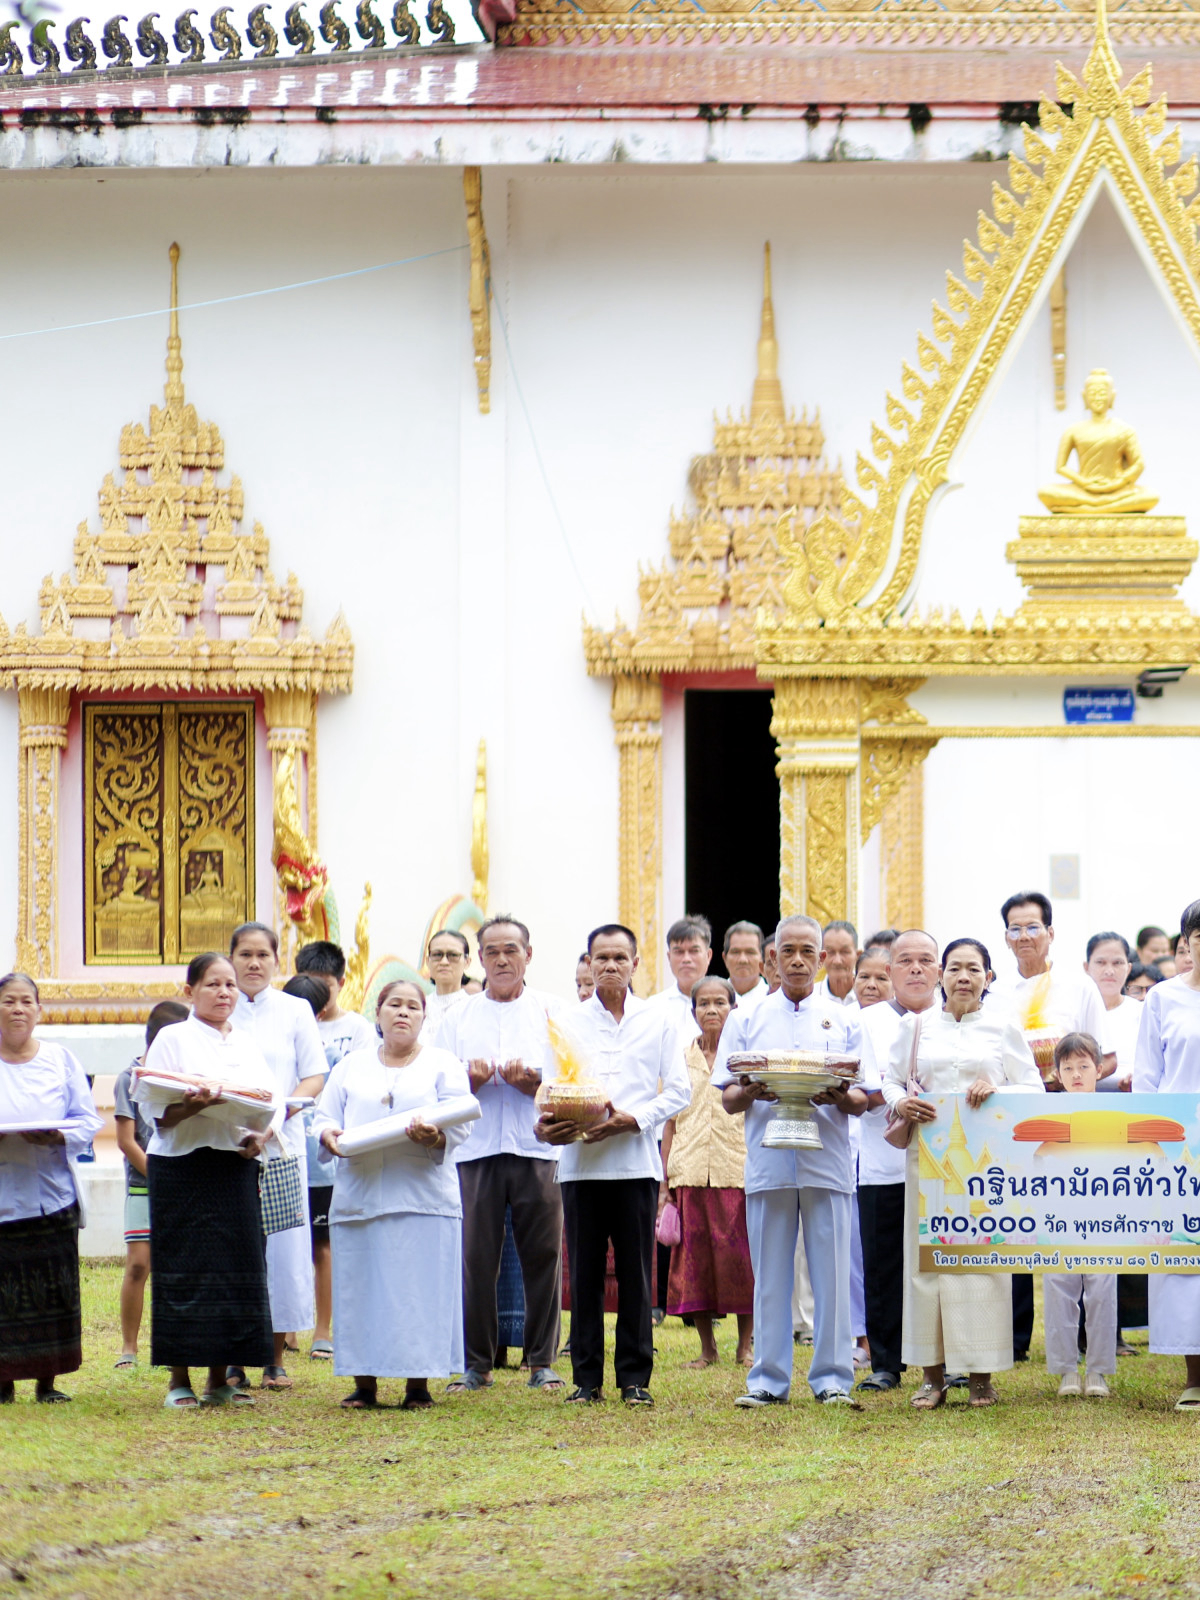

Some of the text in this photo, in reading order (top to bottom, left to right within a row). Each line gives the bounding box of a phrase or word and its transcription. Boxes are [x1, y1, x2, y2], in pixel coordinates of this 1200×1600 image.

[930, 1215, 1036, 1236] ๓๐,๐๐๐
[1044, 1213, 1067, 1233] วัด
[1073, 1213, 1174, 1240] พุทธศักราช
[933, 1251, 957, 1265] โดย
[962, 1252, 1059, 1269] คณะศิษยานุศิษย์
[1064, 1256, 1123, 1270] บูชาธรรม
[1127, 1257, 1146, 1266] ๘๑
[1150, 1252, 1159, 1266] ปี
